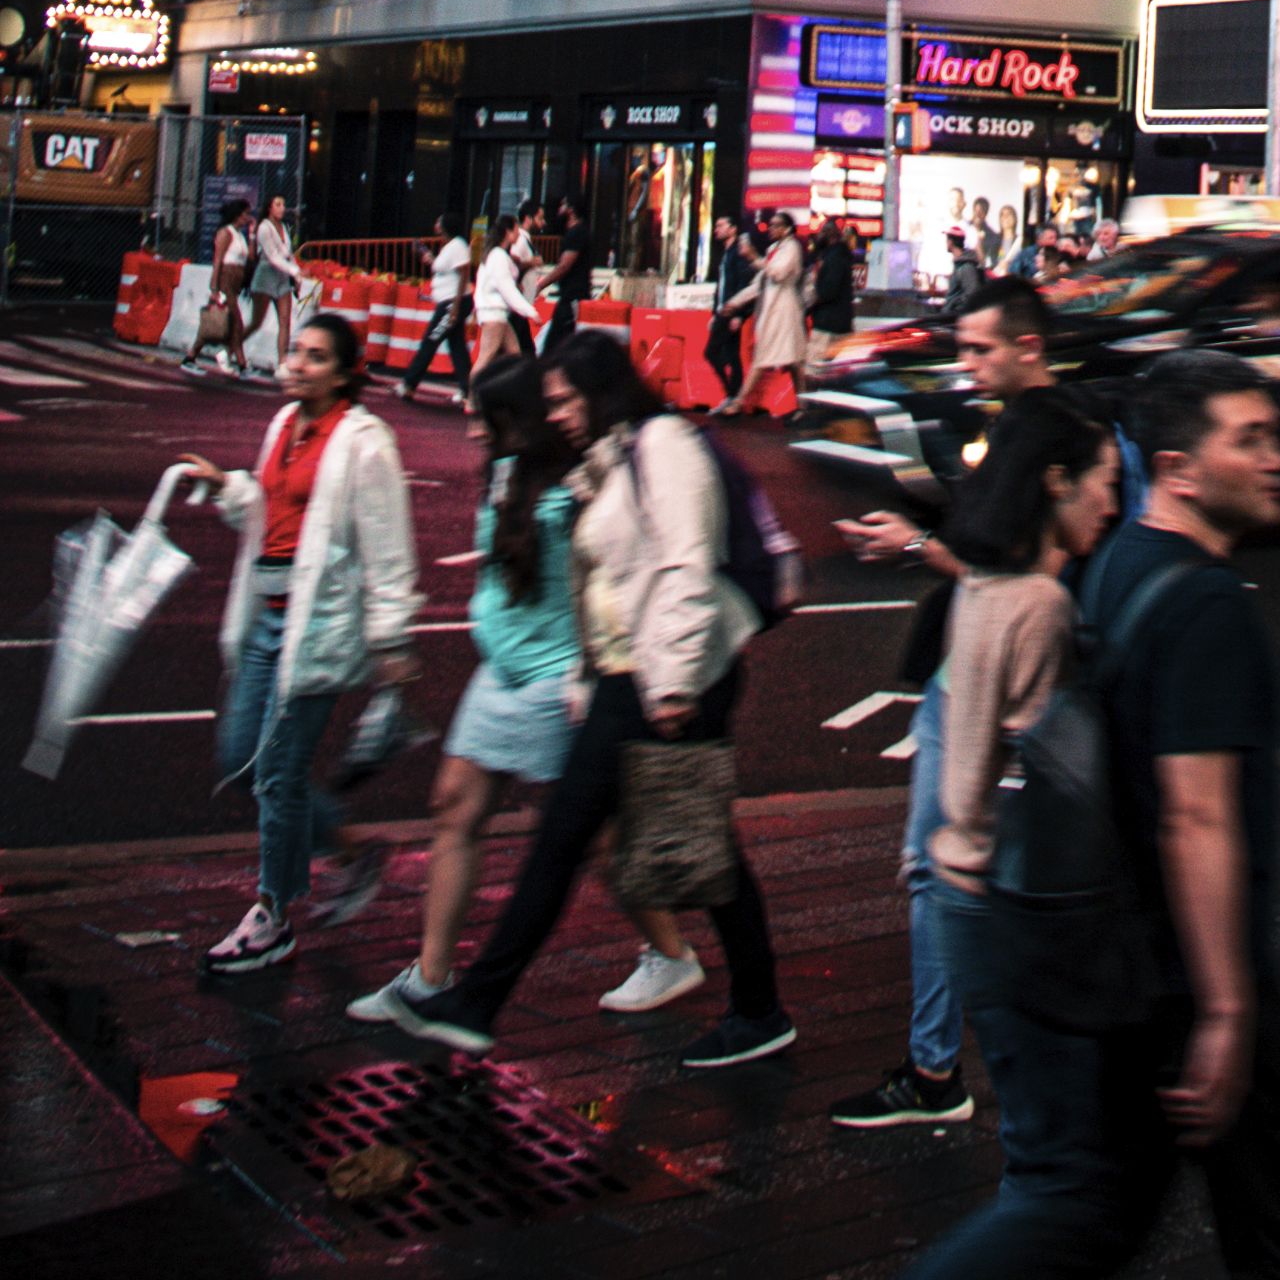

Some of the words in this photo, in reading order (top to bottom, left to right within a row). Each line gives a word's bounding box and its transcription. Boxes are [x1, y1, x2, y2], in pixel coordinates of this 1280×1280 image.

[916, 44, 1002, 87] Hard
[1001, 50, 1079, 99] Rock
[626, 105, 653, 124] ROCK
[653, 104, 680, 124] SHOP
[930, 114, 974, 135] OCK
[977, 116, 1035, 138] SHOP
[45, 133, 100, 170] CAT
